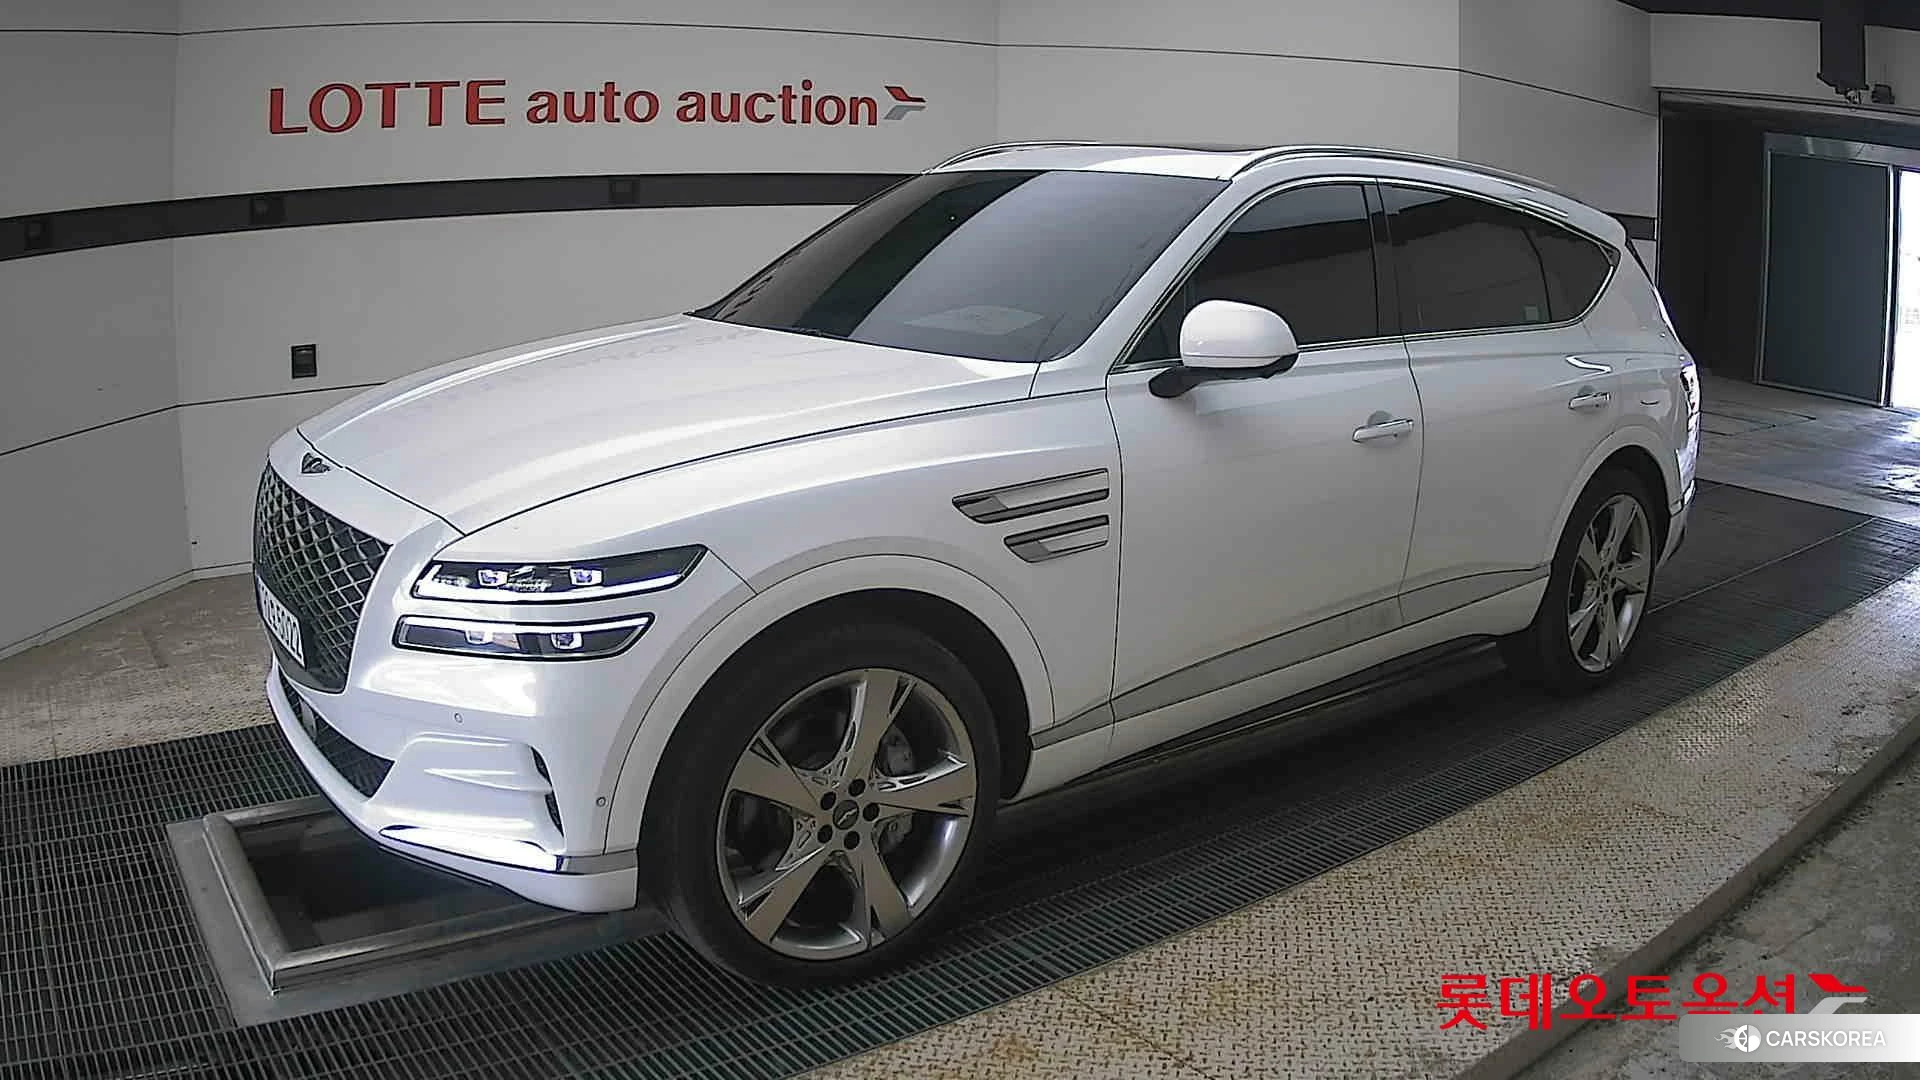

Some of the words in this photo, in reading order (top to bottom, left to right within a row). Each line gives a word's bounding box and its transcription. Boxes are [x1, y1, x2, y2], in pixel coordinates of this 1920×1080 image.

[269, 79, 506, 134] LOTTE
[527, 81, 660, 124] auto
[676, 80, 878, 126] auction
